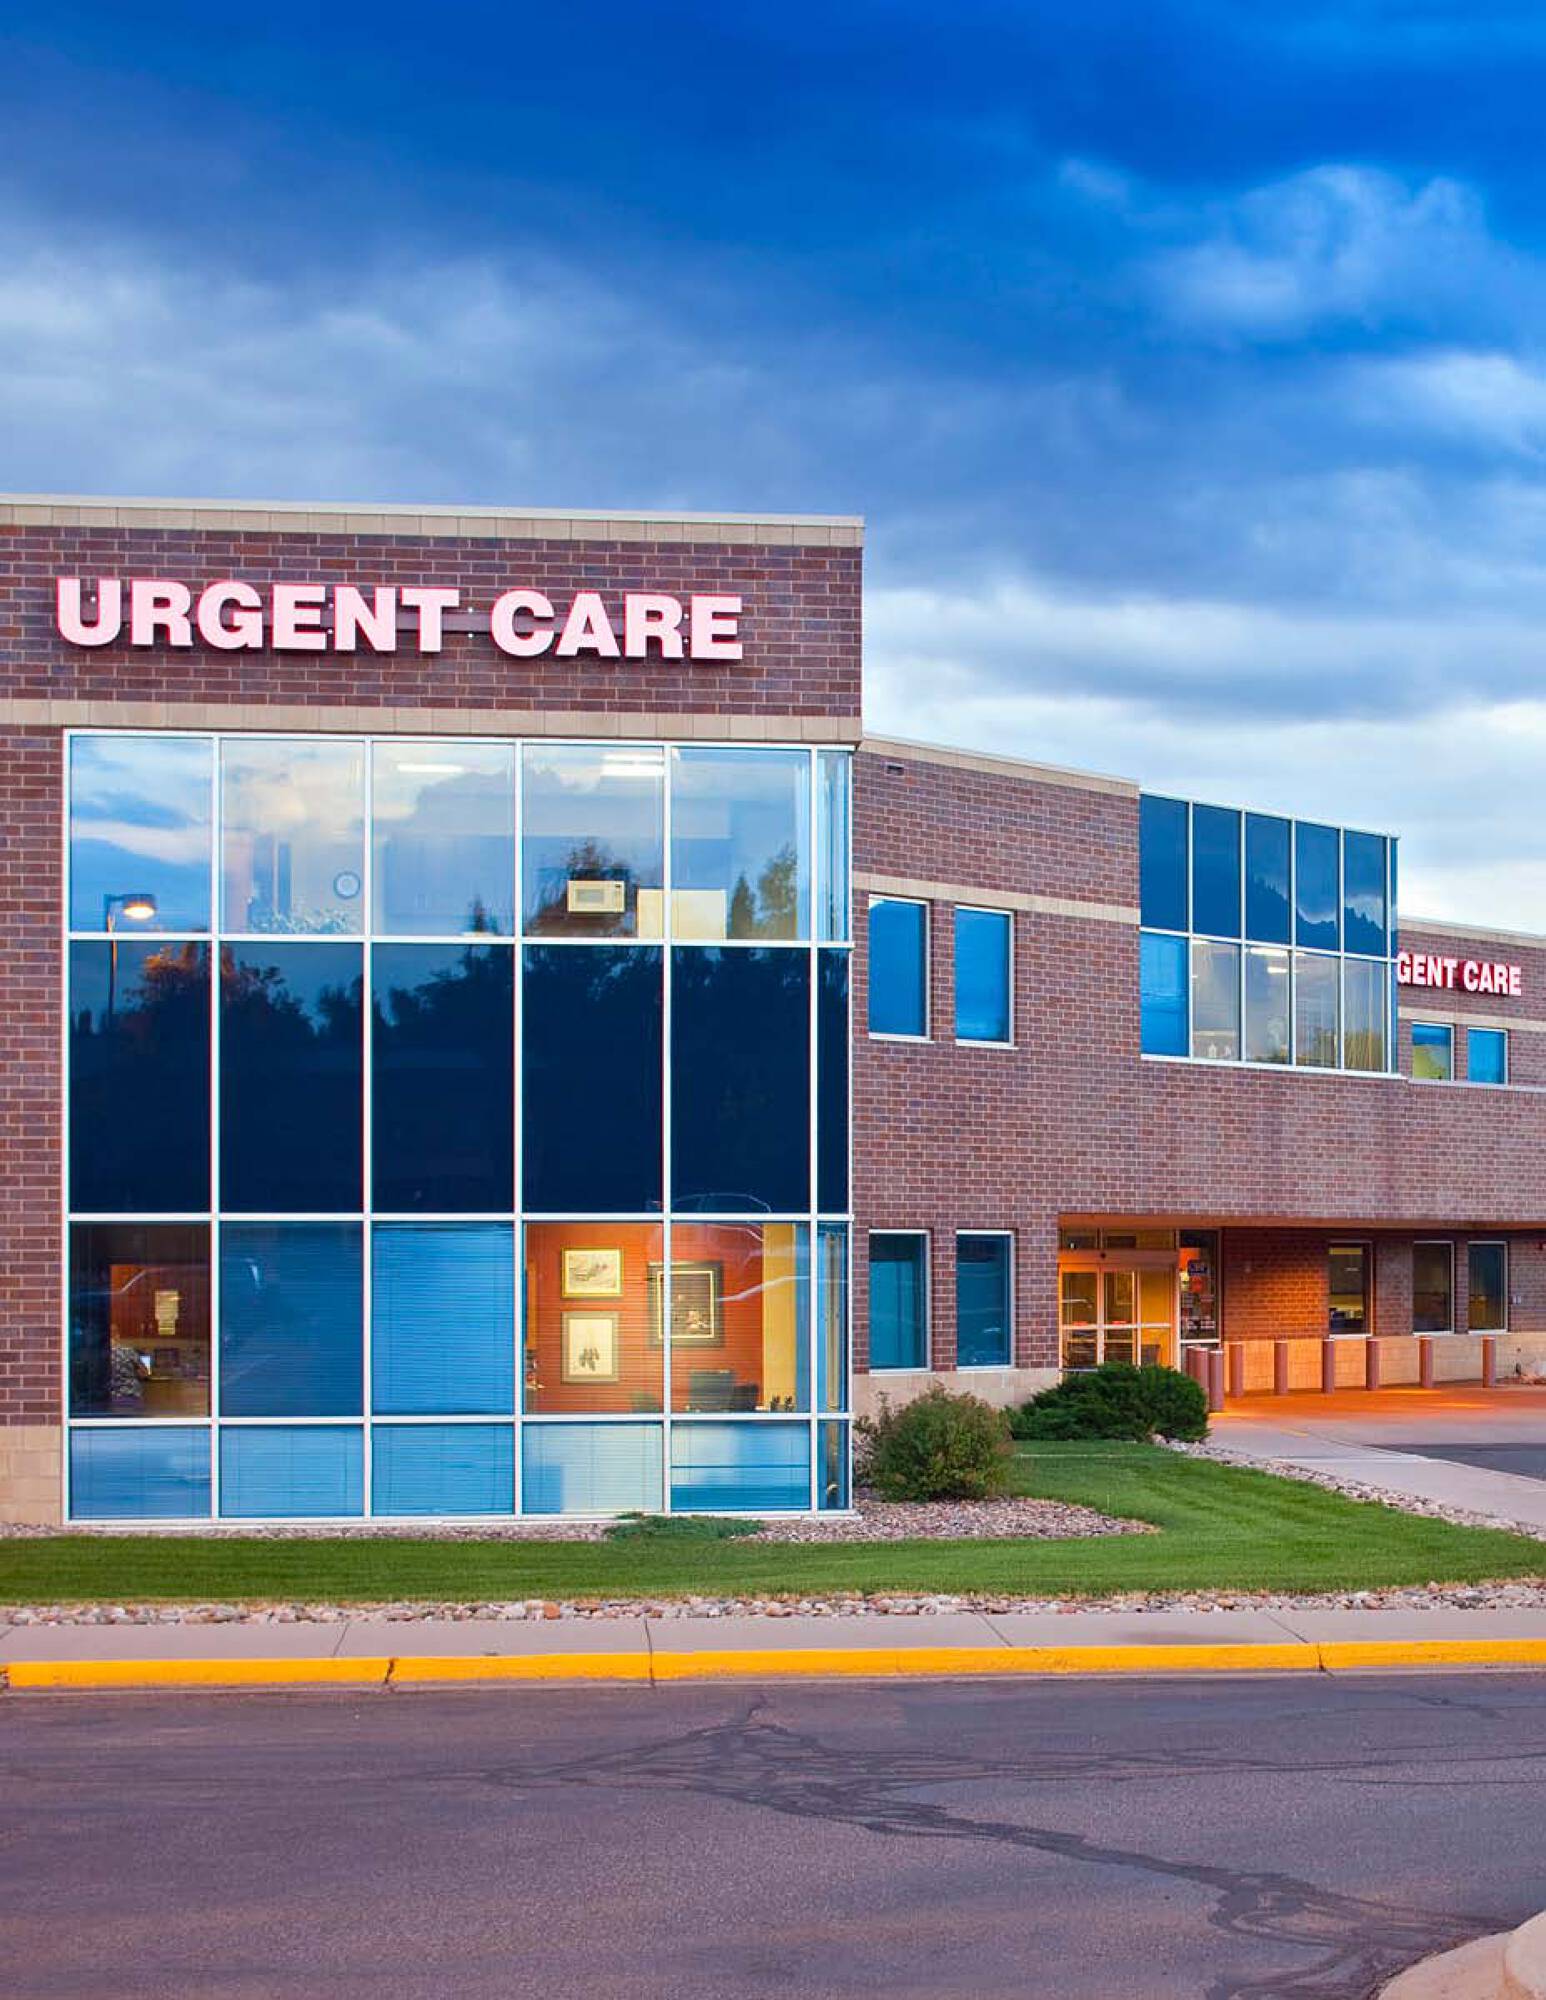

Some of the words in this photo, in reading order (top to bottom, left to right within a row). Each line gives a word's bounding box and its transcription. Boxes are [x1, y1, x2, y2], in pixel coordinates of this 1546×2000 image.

[56, 577, 461, 653] URGENT
[491, 589, 743, 661] CARE
[1397, 952, 1458, 989] GENT
[1463, 960, 1521, 996] CARE
